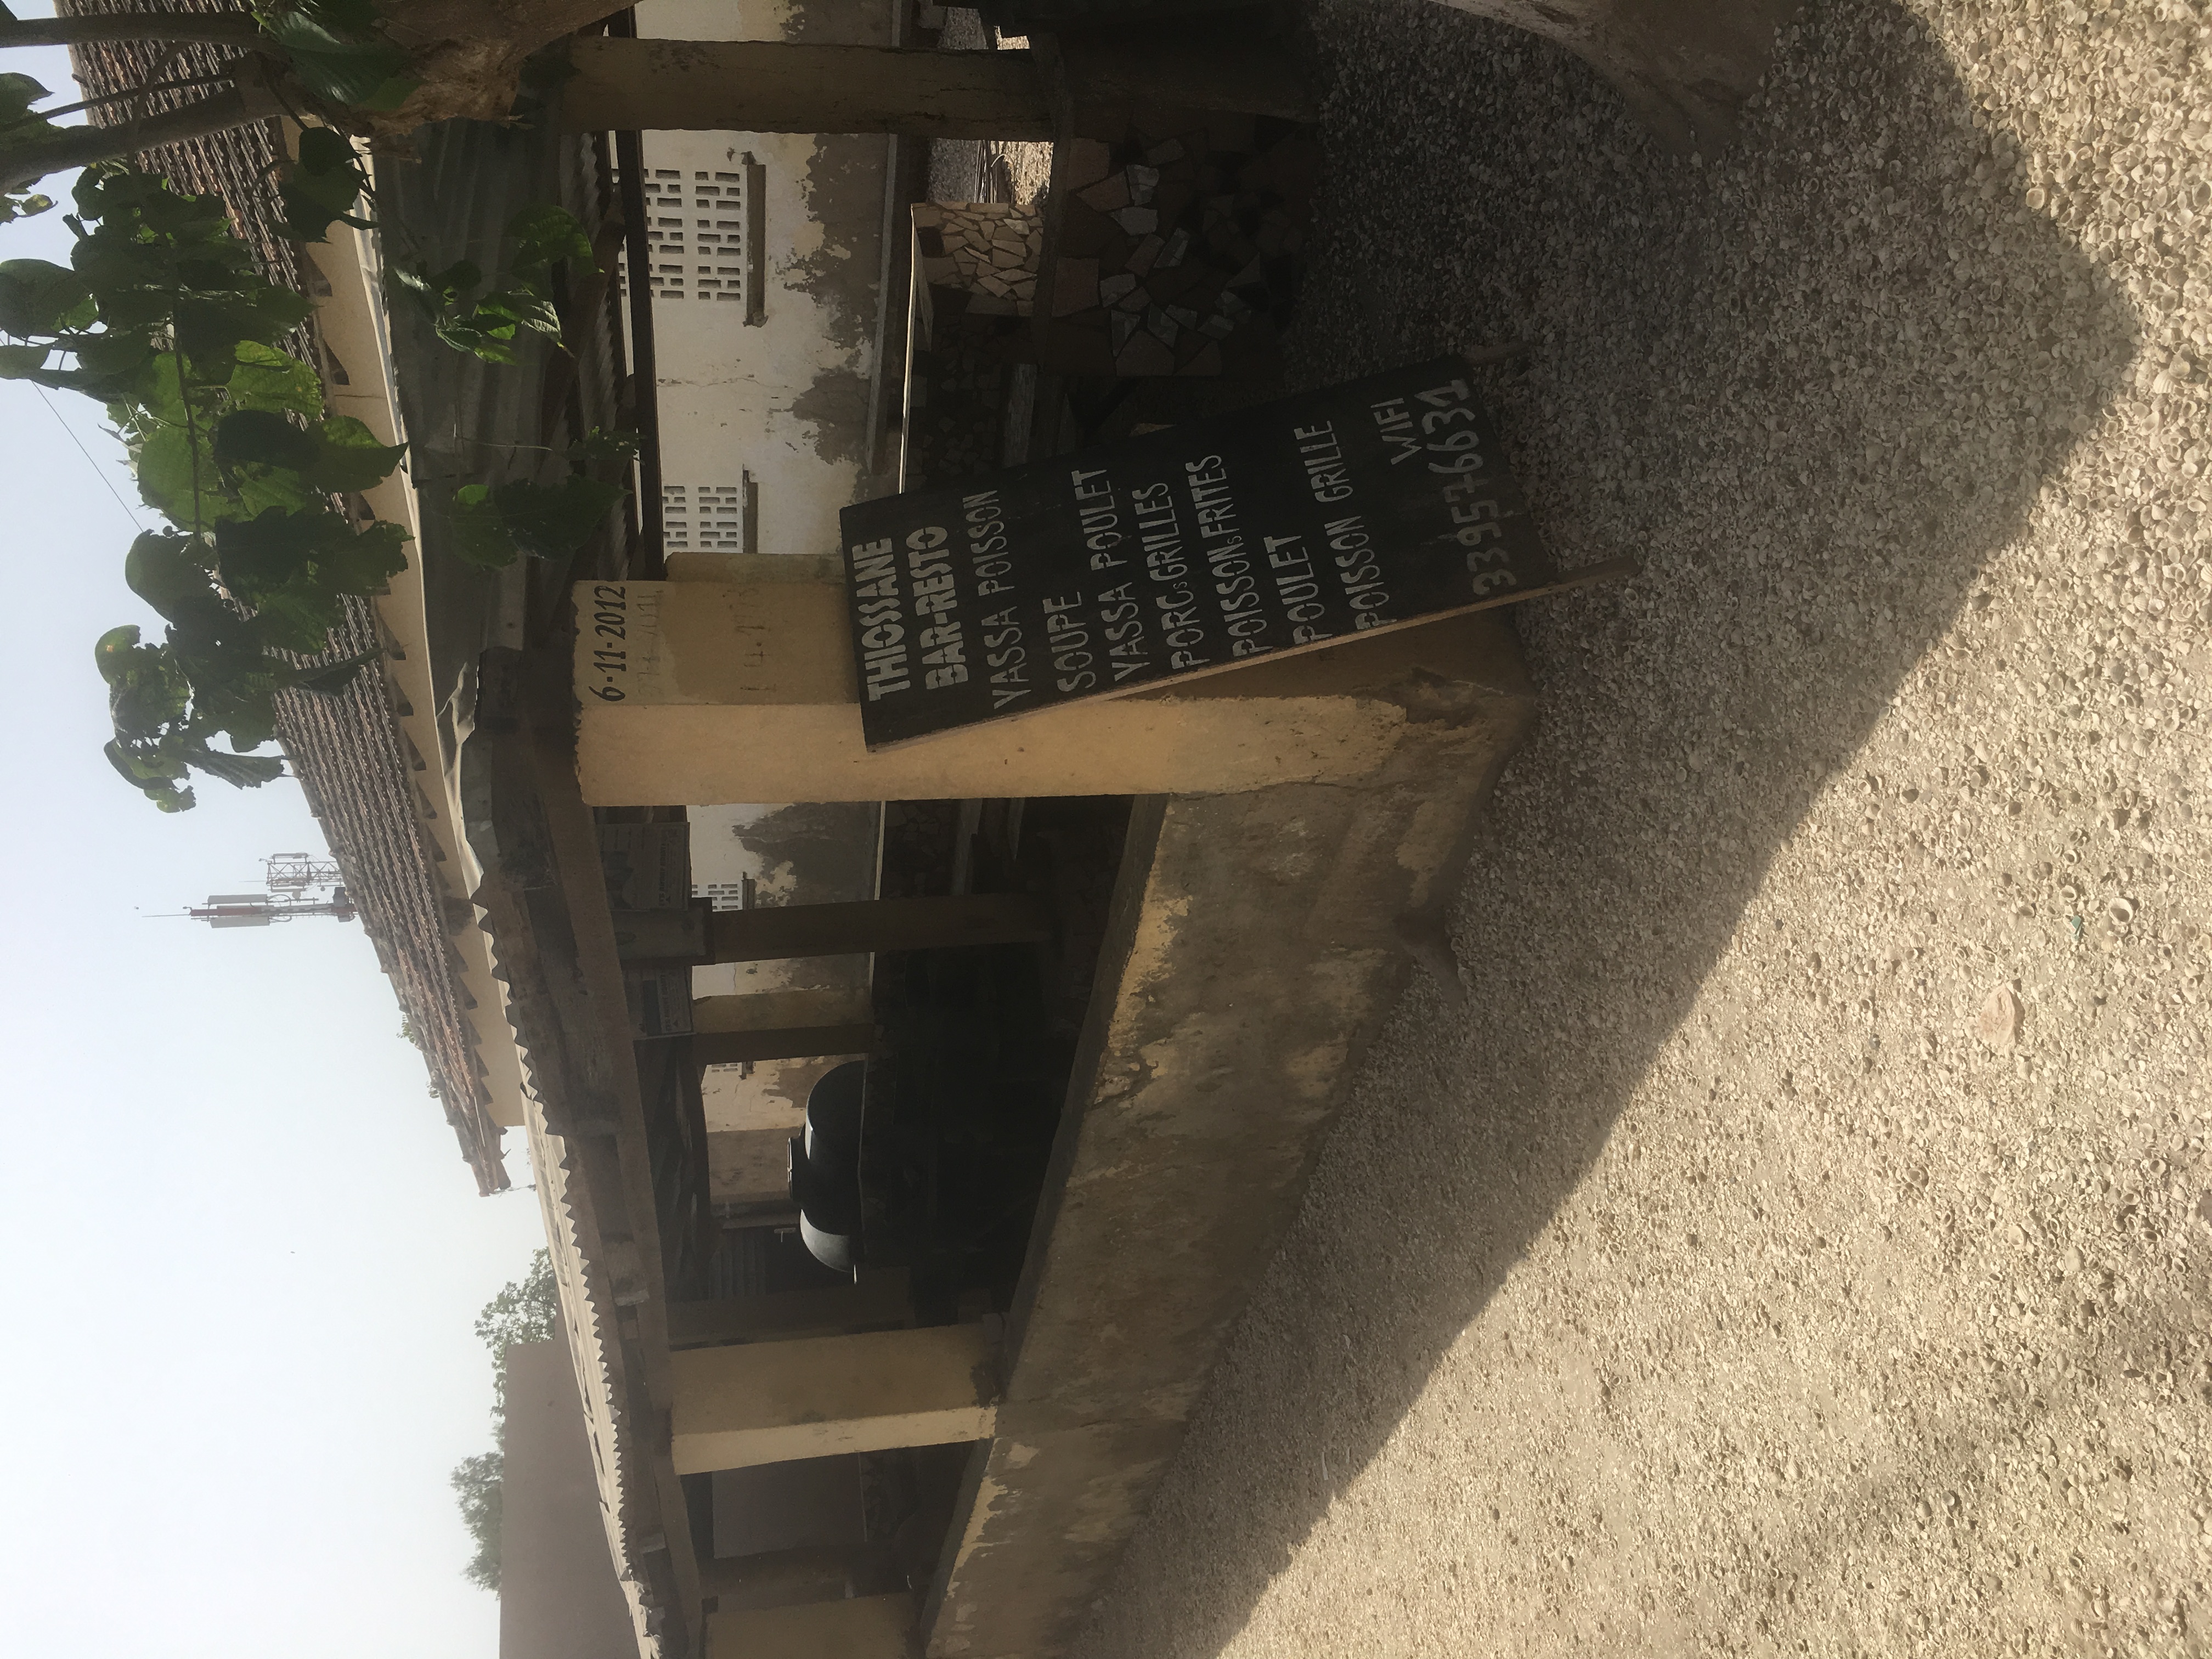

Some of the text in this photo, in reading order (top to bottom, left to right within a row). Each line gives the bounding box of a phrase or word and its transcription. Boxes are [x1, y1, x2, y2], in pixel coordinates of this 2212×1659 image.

[1371, 398, 1421, 465] WIFI
[1414, 378, 1518, 597] 339576631
[963, 490, 1031, 709] YASSA POISSON
[1071, 470, 1150, 681] YASSA POULET
[1263, 536, 1332, 644] POULET
[1294, 421, 1397, 629] POISSON GRILLE
[853, 538, 910, 701] THIOSSANE
[906, 527, 968, 689] BAR-RESTO
[1043, 592, 1096, 691] SOUPE
